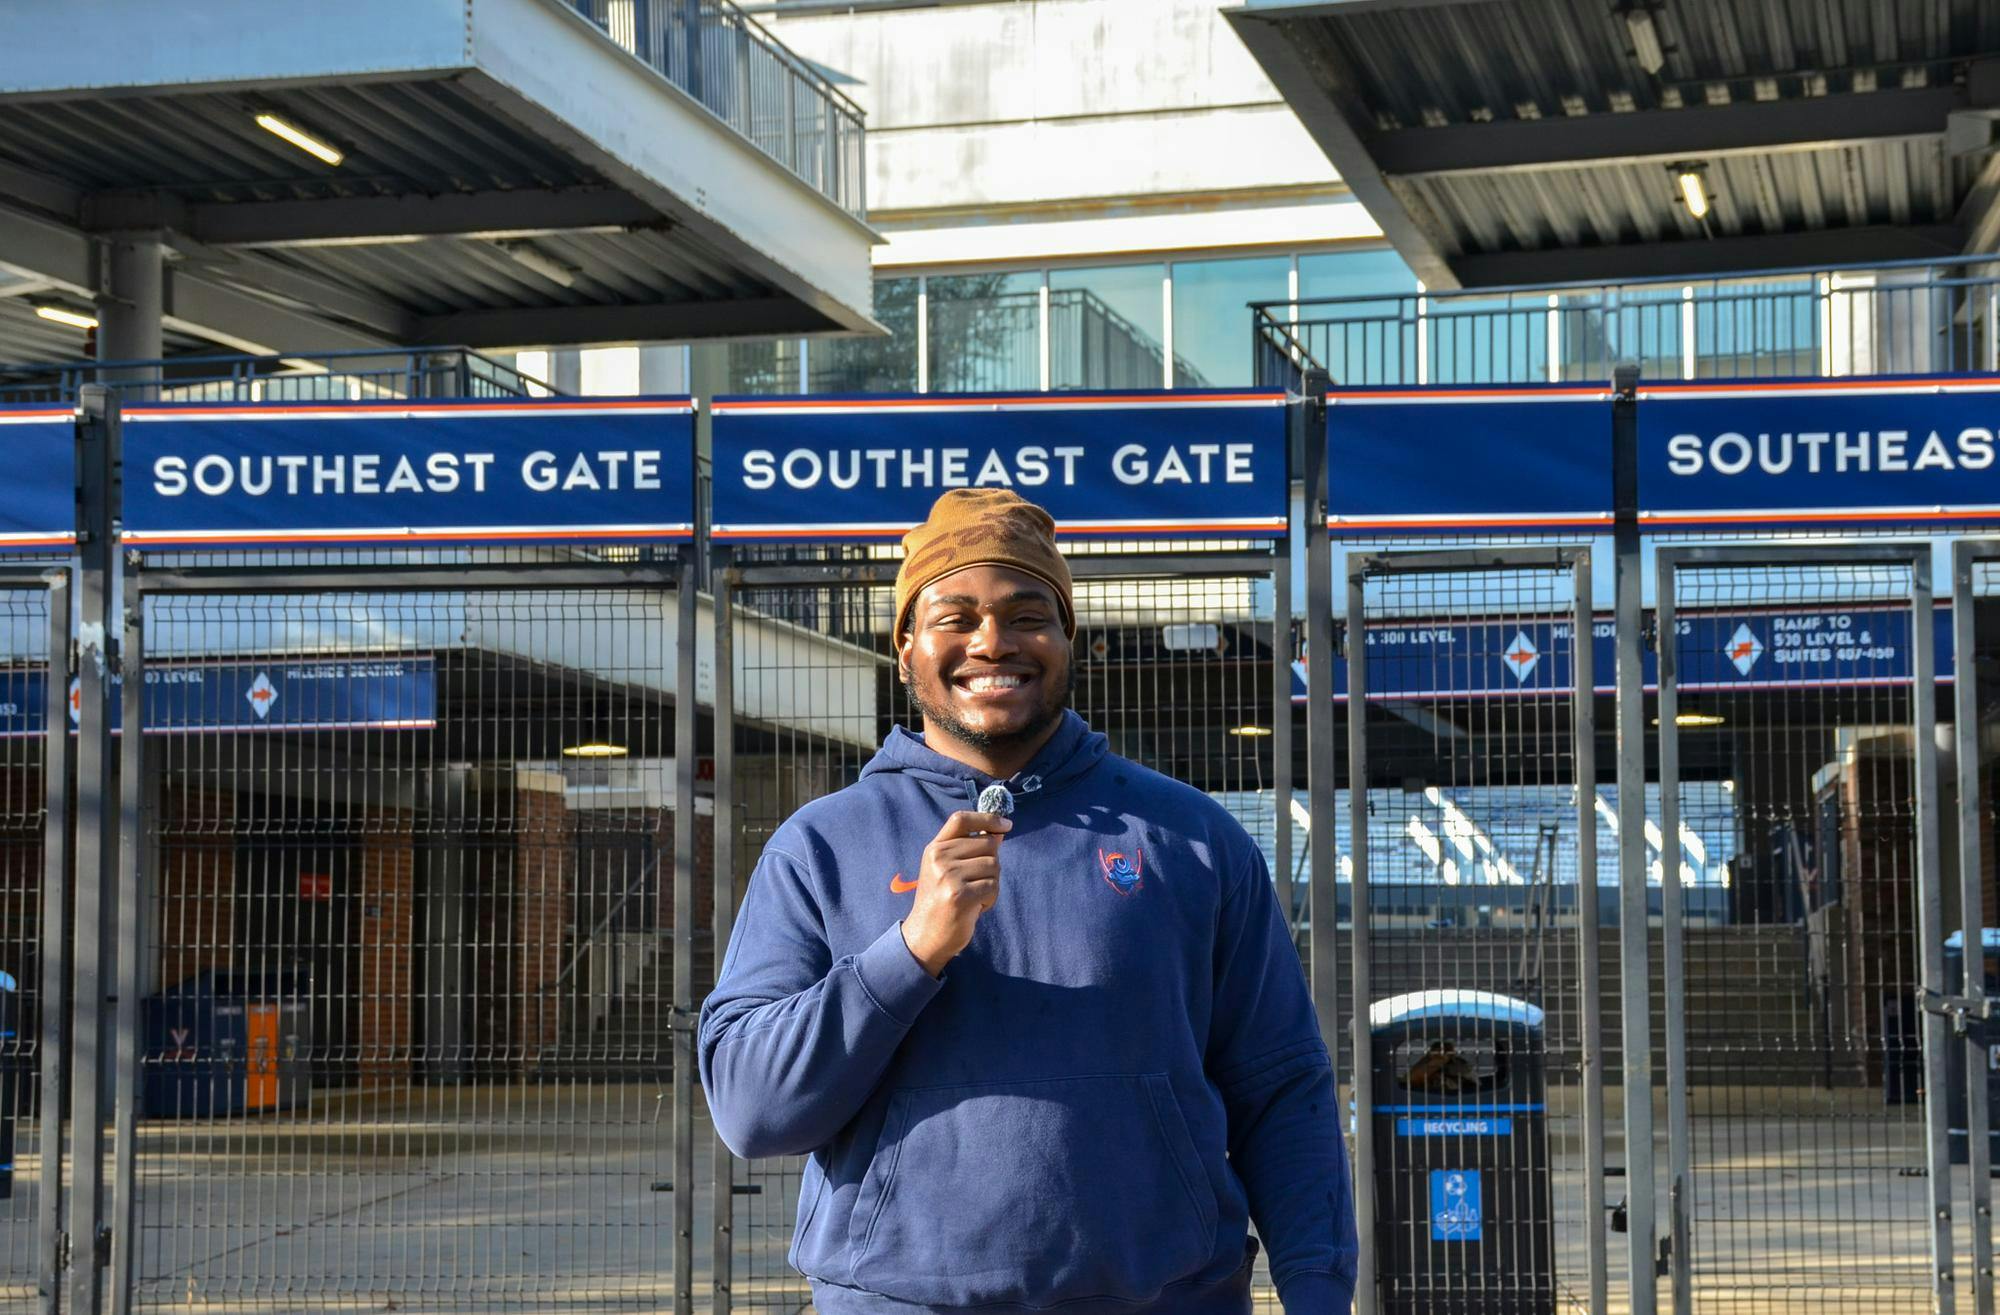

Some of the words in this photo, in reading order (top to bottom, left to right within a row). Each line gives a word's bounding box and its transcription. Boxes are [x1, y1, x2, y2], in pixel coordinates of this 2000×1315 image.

[1668, 428, 2000, 475] SOUTHEAS
[154, 452, 495, 496] SOUTHEAST
[521, 450, 661, 492] GATE
[743, 446, 1084, 490] SOUTHEAST
[1112, 443, 1254, 486] GATE
[1773, 616, 1823, 631] RAMP
[1828, 615, 1852, 629] TO
[1410, 630, 1457, 644] LEVEL
[1806, 631, 1854, 646] LEVEL
[1774, 648, 1831, 663] SUITES
[163, 671, 204, 684] LEVEL
[1423, 1121, 1489, 1134] RECYCLING
